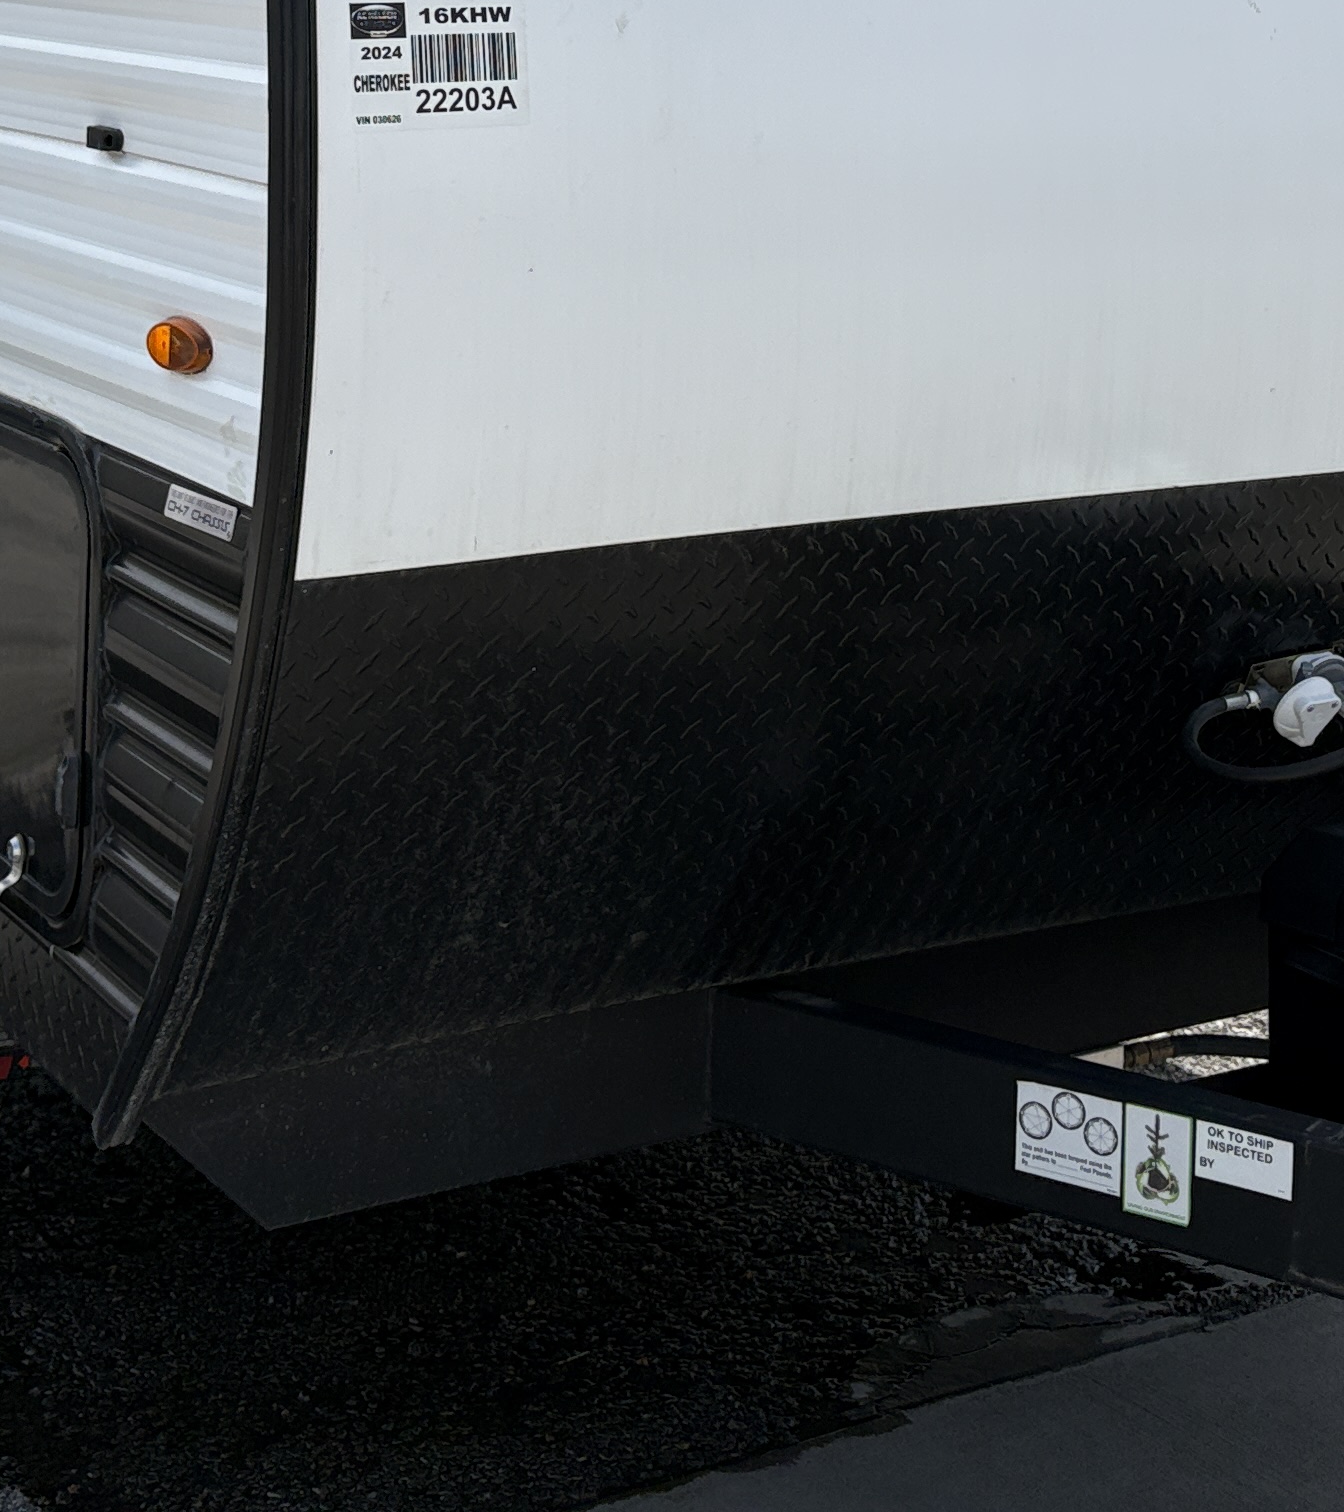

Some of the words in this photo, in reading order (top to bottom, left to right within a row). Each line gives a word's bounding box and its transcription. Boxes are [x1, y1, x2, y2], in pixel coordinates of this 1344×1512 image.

[418, 6, 512, 25] 16KHW
[360, 45, 403, 61] 2024
[353, 73, 411, 93] CHEROKEE
[415, 85, 518, 114] 22203A
[355, 115, 371, 126] VIN
[1207, 1126, 1225, 1140] OK
[1228, 1130, 1244, 1144] TO
[1246, 1135, 1274, 1150] SHIP
[1206, 1138, 1273, 1164] INSPECTED
[1199, 1155, 1215, 1168] BY
